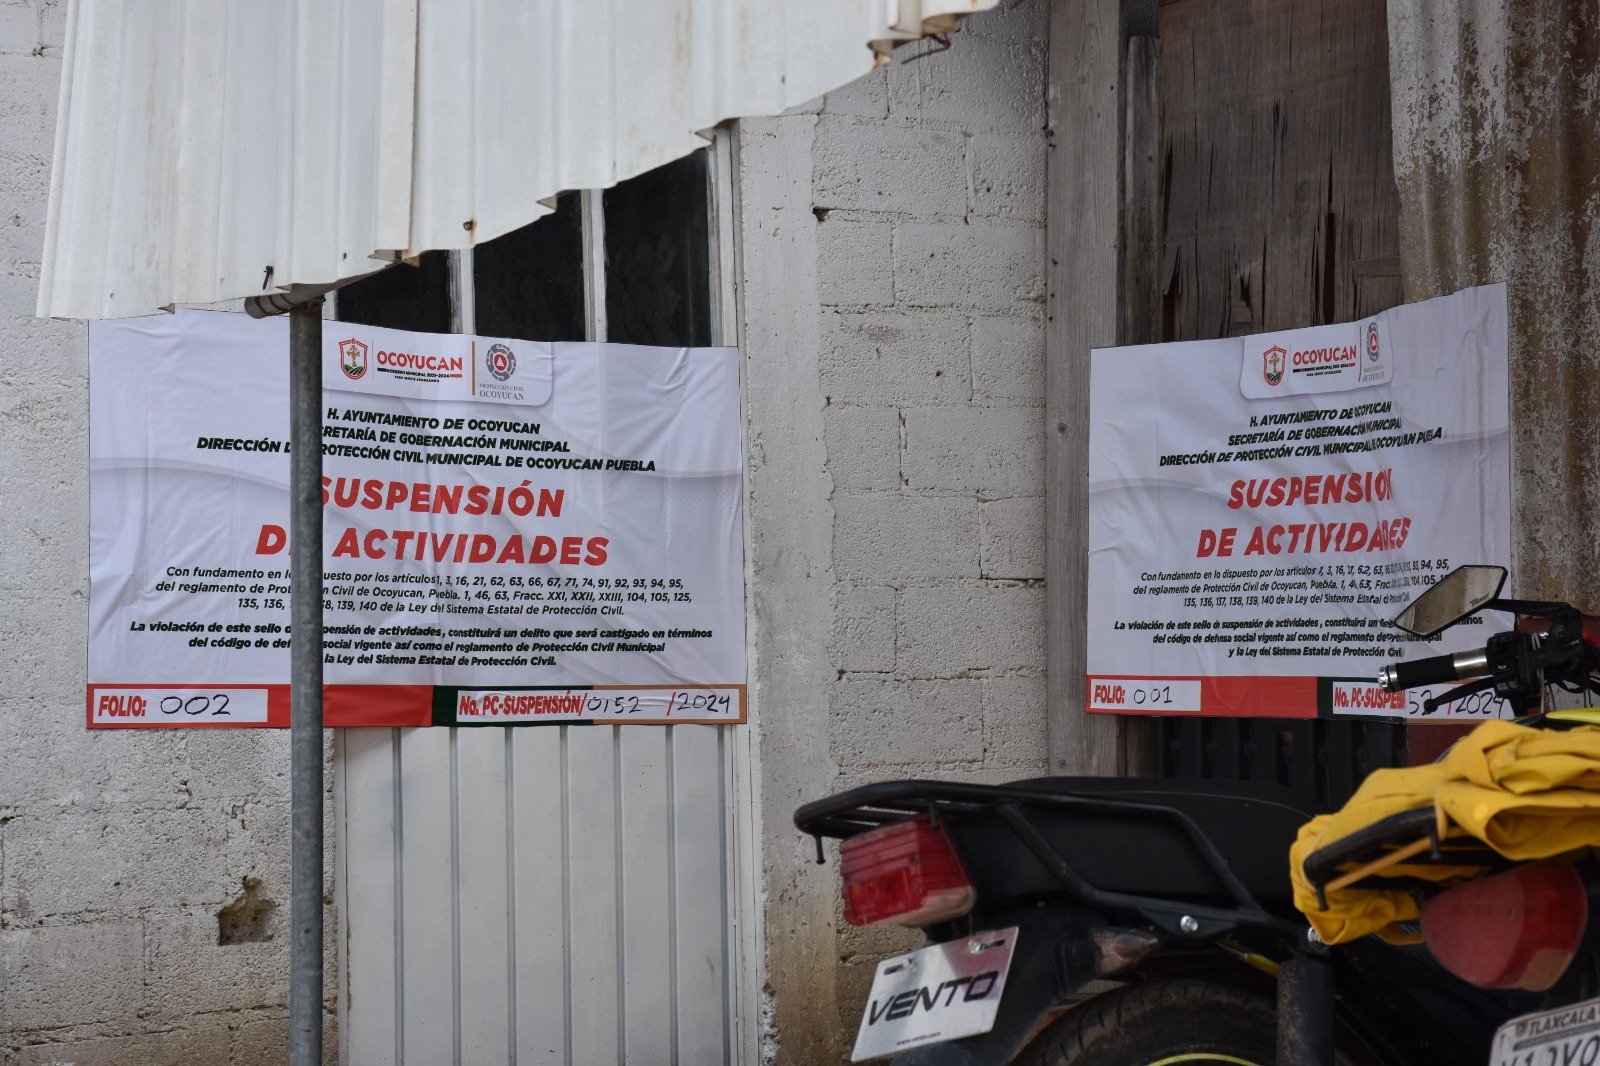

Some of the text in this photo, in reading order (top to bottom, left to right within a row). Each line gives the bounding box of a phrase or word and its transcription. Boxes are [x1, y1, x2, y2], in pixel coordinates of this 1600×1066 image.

[377, 351, 462, 370] OCOYUCAN
[1293, 345, 1356, 366] OCOYUCAN
[480, 390, 524, 400] OCOYUCAN
[327, 408, 540, 434] H. AYUNTAMIENTO DE OCOYUCAN
[1250, 416, 1258, 427] H.
[1260, 409, 1338, 426] AYUNTAMIENTO
[1339, 408, 1353, 420] DE
[380, 431, 396, 443] DE
[399, 434, 496, 448] GOBERNACIÓN
[500, 439, 570, 452] MUNICIPAL
[1228, 428, 1284, 446] SECRETARÍA
[1287, 429, 1303, 440] DE
[197, 437, 281, 453] DIRECCIÓN
[394, 449, 424, 463] CIVIL
[426, 454, 501, 466] MUNICIPAL
[506, 456, 523, 467] DE
[526, 457, 603, 470] OCOYUCAN
[606, 459, 656, 471] PUEBLA
[1160, 450, 1216, 466] DIRECCIÓN
[1217, 452, 1234, 462] DE
[1233, 444, 1294, 461] PROTECCIÓN
[1295, 445, 1321, 456] CIVIL
[1324, 440, 1372, 455] MUNICIPAL
[322, 476, 564, 518] SUSPENSIÓN
[332, 527, 610, 566] ACTIVIDADES
[1197, 517, 1412, 558] DE ACTIVIDADES
[167, 567, 189, 577] Con
[193, 567, 264, 579] fundamento
[268, 570, 281, 578] en
[354, 573, 372, 582] por
[375, 572, 389, 582] los
[446, 576, 452, 586] 3,
[456, 576, 469, 586] 16,
[473, 577, 487, 586] 21,
[490, 577, 506, 587] 62,
[510, 577, 524, 587] 63,
[528, 578, 543, 587] 66,
[547, 578, 561, 587] 67,
[564, 578, 578, 588] 71,
[582, 578, 596, 588] 74,
[598, 579, 611, 588] 91,
[615, 579, 629, 588] 92,
[633, 579, 647, 588] 93,
[651, 579, 666, 589] 94,
[669, 579, 683, 589] 95,
[1141, 572, 1156, 581] Con
[1223, 569, 1257, 579] dispuesto
[156, 582, 691, 602] del reglamento de Civil de Ocoyucan, Puebla. 1, 46, 63, Fracc. XXI, XXII, XXIII, 104, 105, 125,
[1149, 582, 1259, 595] reglamento Protección Civil
[238, 598, 259, 609] 135,
[264, 599, 285, 610] 136,
[337, 601, 355, 611] 139,
[360, 601, 377, 611] 140
[380, 602, 393, 611] de
[396, 602, 405, 611] la
[408, 604, 427, 613] Ley
[430, 603, 444, 613] del
[447, 605, 483, 614] Sistema
[487, 605, 522, 614] Estatal
[526, 606, 539, 614] de
[542, 606, 597, 615] Protección
[601, 606, 624, 615] Civil.
[131, 622, 145, 631] La
[150, 622, 204, 632] violación
[208, 622, 222, 632] de
[226, 624, 251, 633] este
[254, 623, 281, 633] sello
[364, 626, 375, 635] de
[448, 627, 501, 637] constituirá
[521, 628, 550, 637] delito
[553, 630, 573, 639] que
[576, 628, 597, 637] será
[600, 629, 649, 639] castigado
[668, 628, 712, 638] términos
[189, 637, 207, 647] del
[211, 637, 251, 649] código
[255, 638, 269, 648] de
[323, 639, 351, 649] social
[355, 640, 392, 651] vigente
[395, 641, 410, 649] así
[444, 643, 453, 651] el
[456, 643, 512, 653] reglamento
[516, 643, 529, 651] de
[532, 641, 588, 652] Protección
[591, 643, 614, 651] Civil
[616, 643, 665, 653] Municipal
[325, 654, 556, 666] la Ley del Sistema Estatal de Protección Civil.
[160, 694, 230, 715] 002
[1094, 685, 1125, 704] FOLIO:
[1134, 686, 1172, 704] 001
[1334, 687, 1349, 708] No.
[98, 695, 146, 717] FOLIO:
[459, 695, 479, 715] No.
[868, 970, 999, 1026] VENTO
[1529, 1007, 1595, 1036] TLAXCALA
